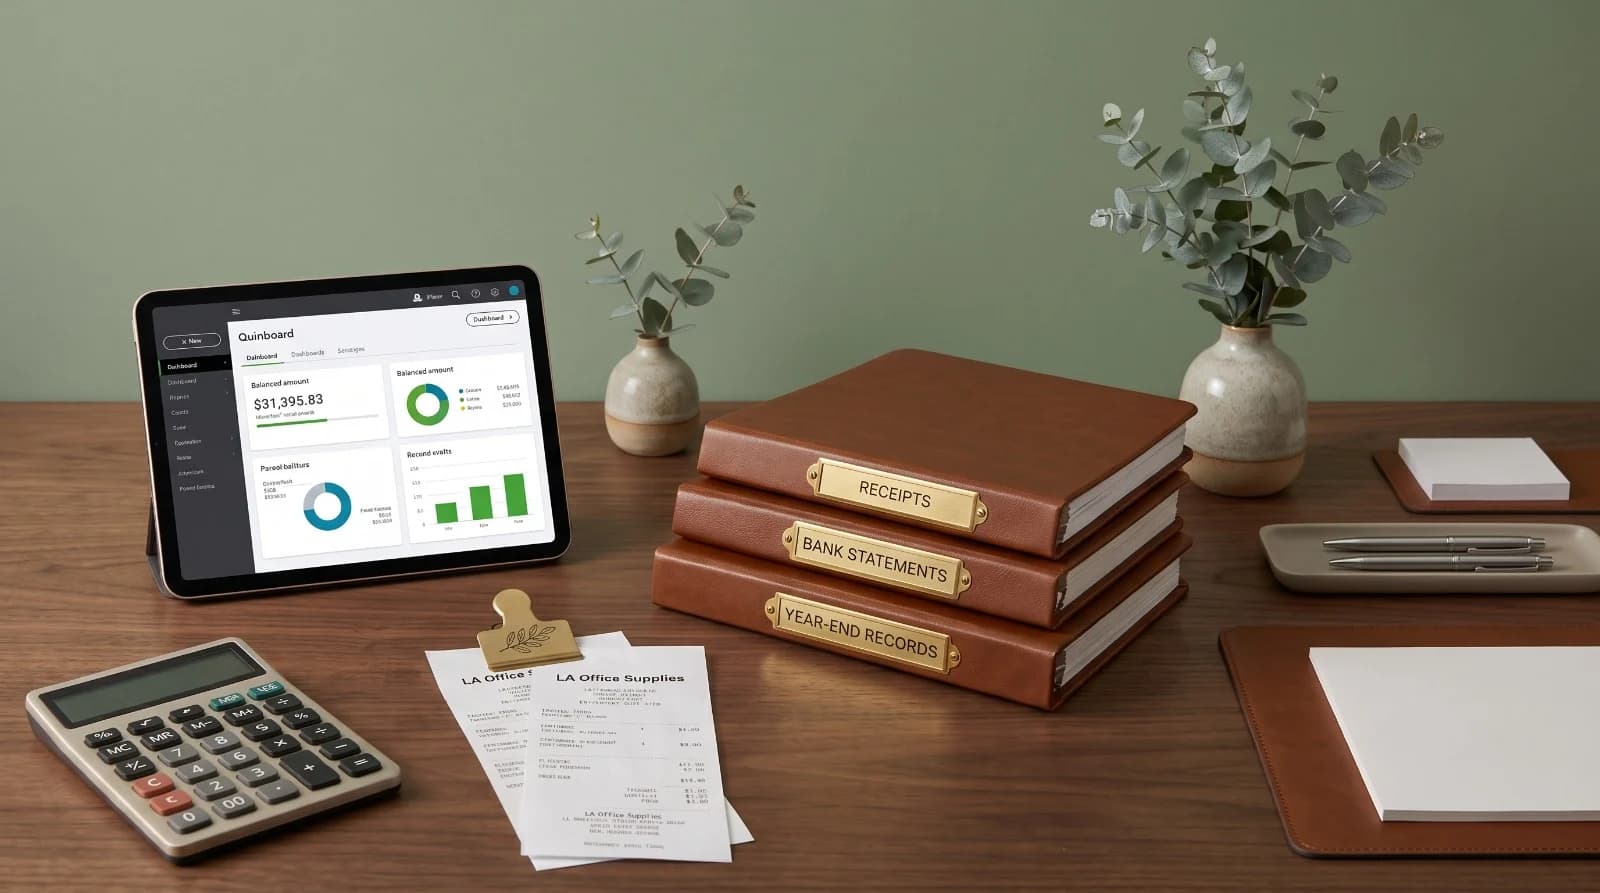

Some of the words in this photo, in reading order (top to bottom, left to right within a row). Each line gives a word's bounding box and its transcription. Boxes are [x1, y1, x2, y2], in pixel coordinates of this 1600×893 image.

[238, 328, 294, 342] Quinboard
[396, 368, 427, 377] Balanced
[428, 366, 454, 375] amount
[251, 379, 282, 389] Balanced
[283, 378, 309, 387] amount
[254, 393, 324, 411] $31,395.83
[860, 480, 931, 508] RECEIPTS
[803, 536, 843, 559] BANK
[847, 547, 948, 583] STATEMENTS
[785, 607, 860, 638] YEAR-END
[865, 628, 938, 659] RECORDS
[462, 676, 482, 685] LA
[484, 671, 525, 683] Office
[556, 673, 575, 682] LA
[579, 674, 620, 682] Office
[624, 674, 685, 684] Supplies
[232, 708, 254, 718] M+
[149, 731, 174, 743] MR
[214, 736, 228, 745] 8
[106, 743, 132, 755] MC
[171, 748, 182, 758] 7
[233, 751, 247, 761] 6
[192, 764, 204, 774] 4
[251, 767, 265, 778] 3
[147, 778, 161, 787] C
[209, 780, 224, 791] 2
[222, 796, 245, 809] 00
[182, 812, 196, 822] 0
[627, 812, 662, 820] Supplies
